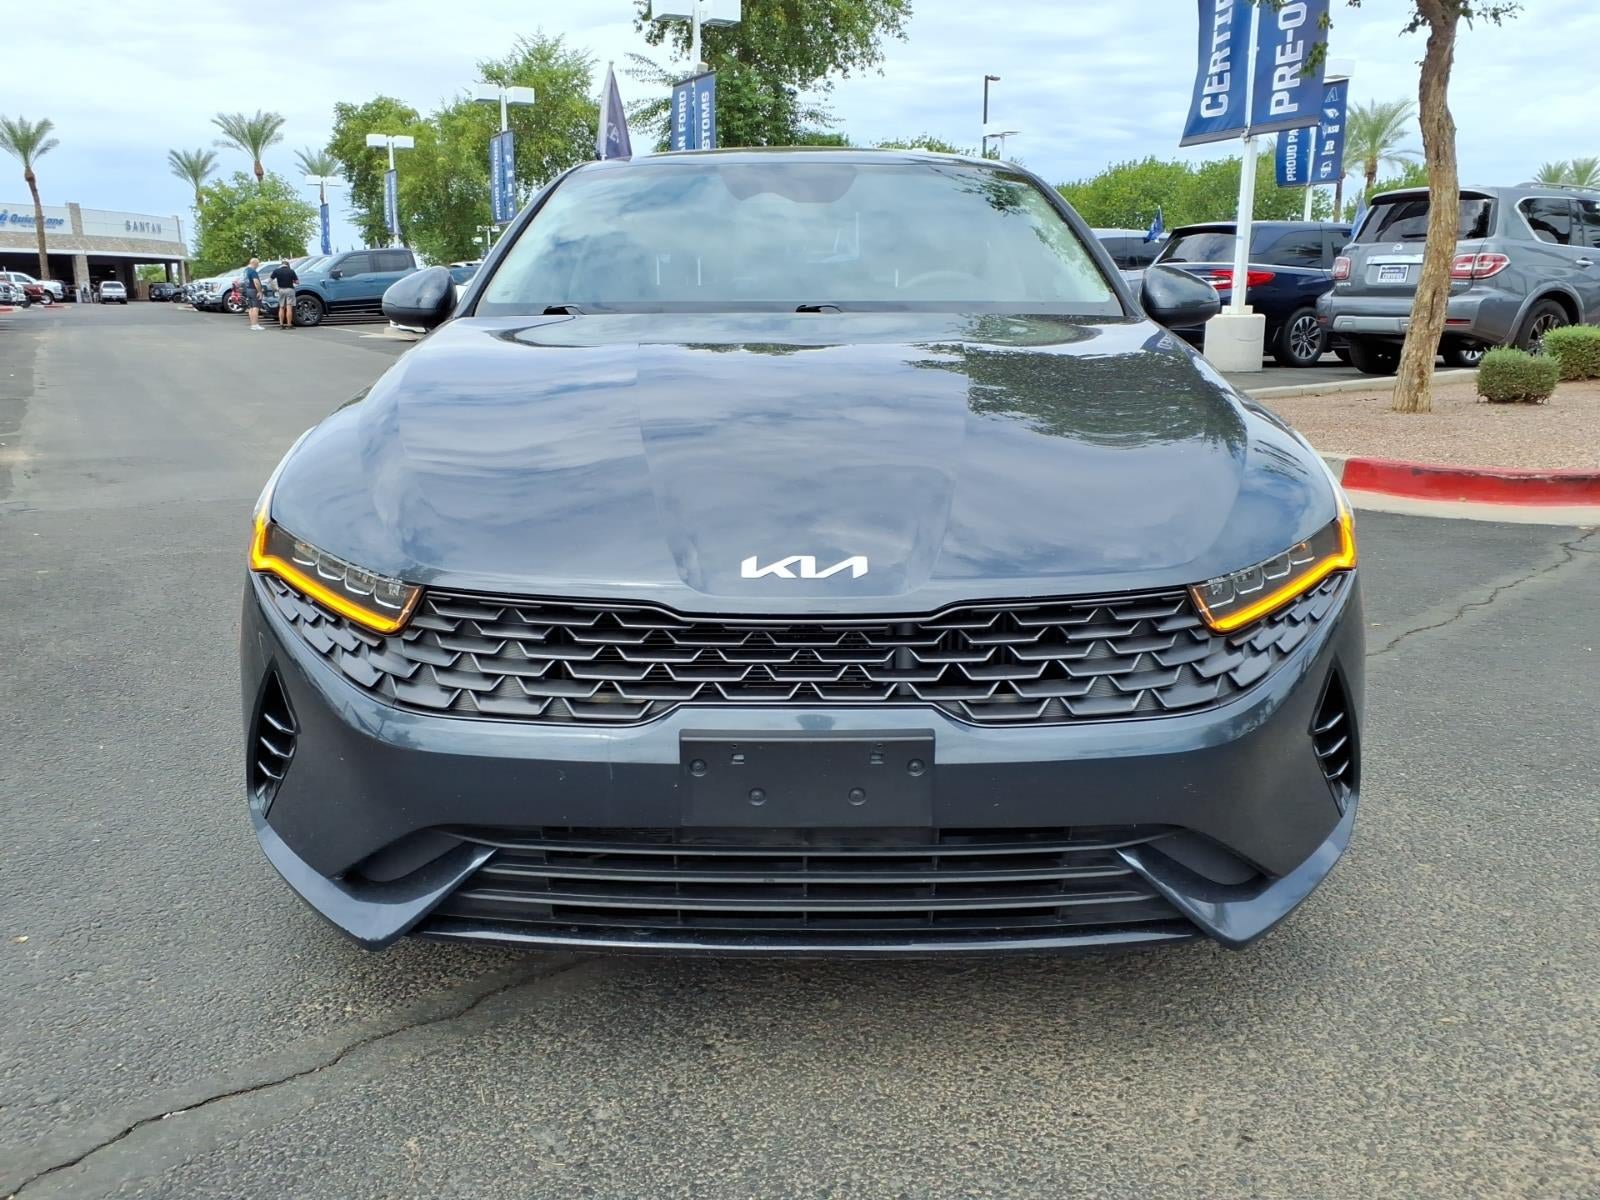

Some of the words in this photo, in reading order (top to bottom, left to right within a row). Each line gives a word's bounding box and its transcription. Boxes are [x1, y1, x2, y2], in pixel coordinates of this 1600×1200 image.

[1269, 0, 1308, 116] PRE-O
[678, 90, 687, 133] FORD
[1286, 144, 1298, 182] PROUD
[494, 187, 502, 220] PROUD
[126, 220, 162, 235] SANTAN
[740, 555, 868, 579] KIA
